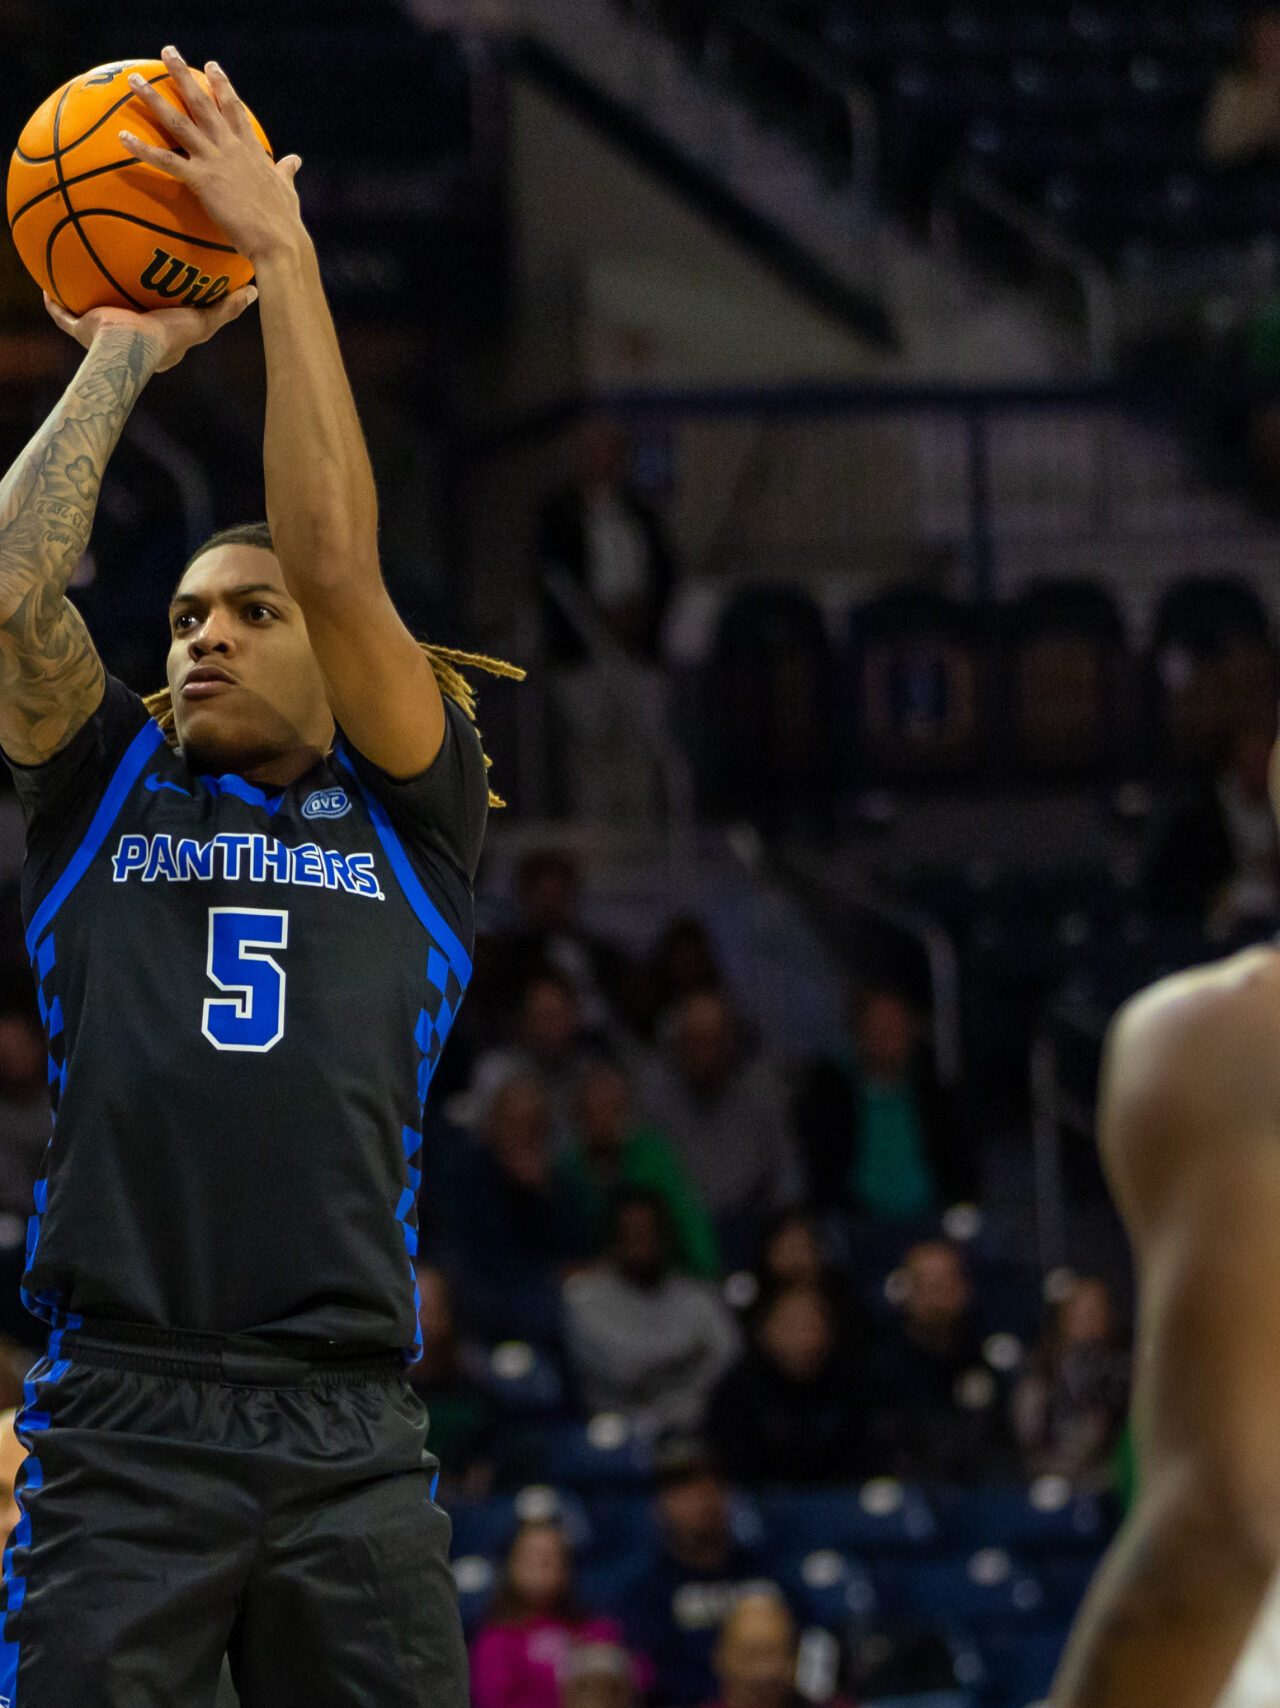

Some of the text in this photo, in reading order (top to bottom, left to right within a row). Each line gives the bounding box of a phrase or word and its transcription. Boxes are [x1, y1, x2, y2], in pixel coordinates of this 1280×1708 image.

[140, 246, 232, 309] Wil
[311, 795, 341, 811] OVC
[111, 833, 381, 899] PANTHERS
[201, 907, 289, 1052] 5
